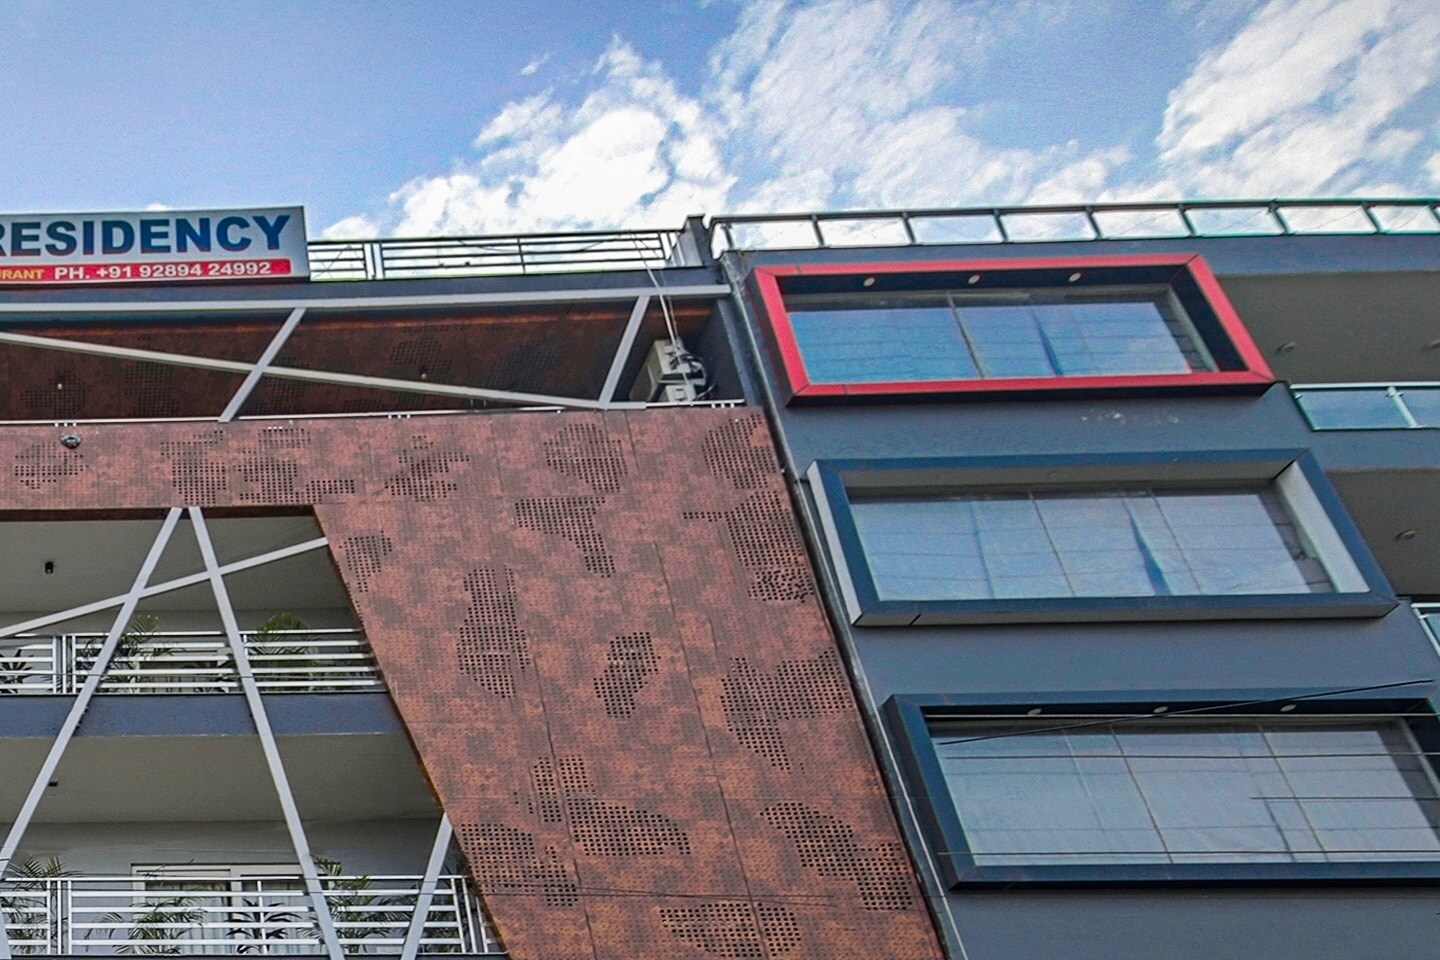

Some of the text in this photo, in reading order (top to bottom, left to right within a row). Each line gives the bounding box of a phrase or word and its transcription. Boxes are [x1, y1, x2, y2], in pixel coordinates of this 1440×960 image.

[54, 266, 90, 280] PH.
[96, 265, 133, 279] +91
[139, 263, 203, 278] 92894
[208, 261, 271, 276] 24992
